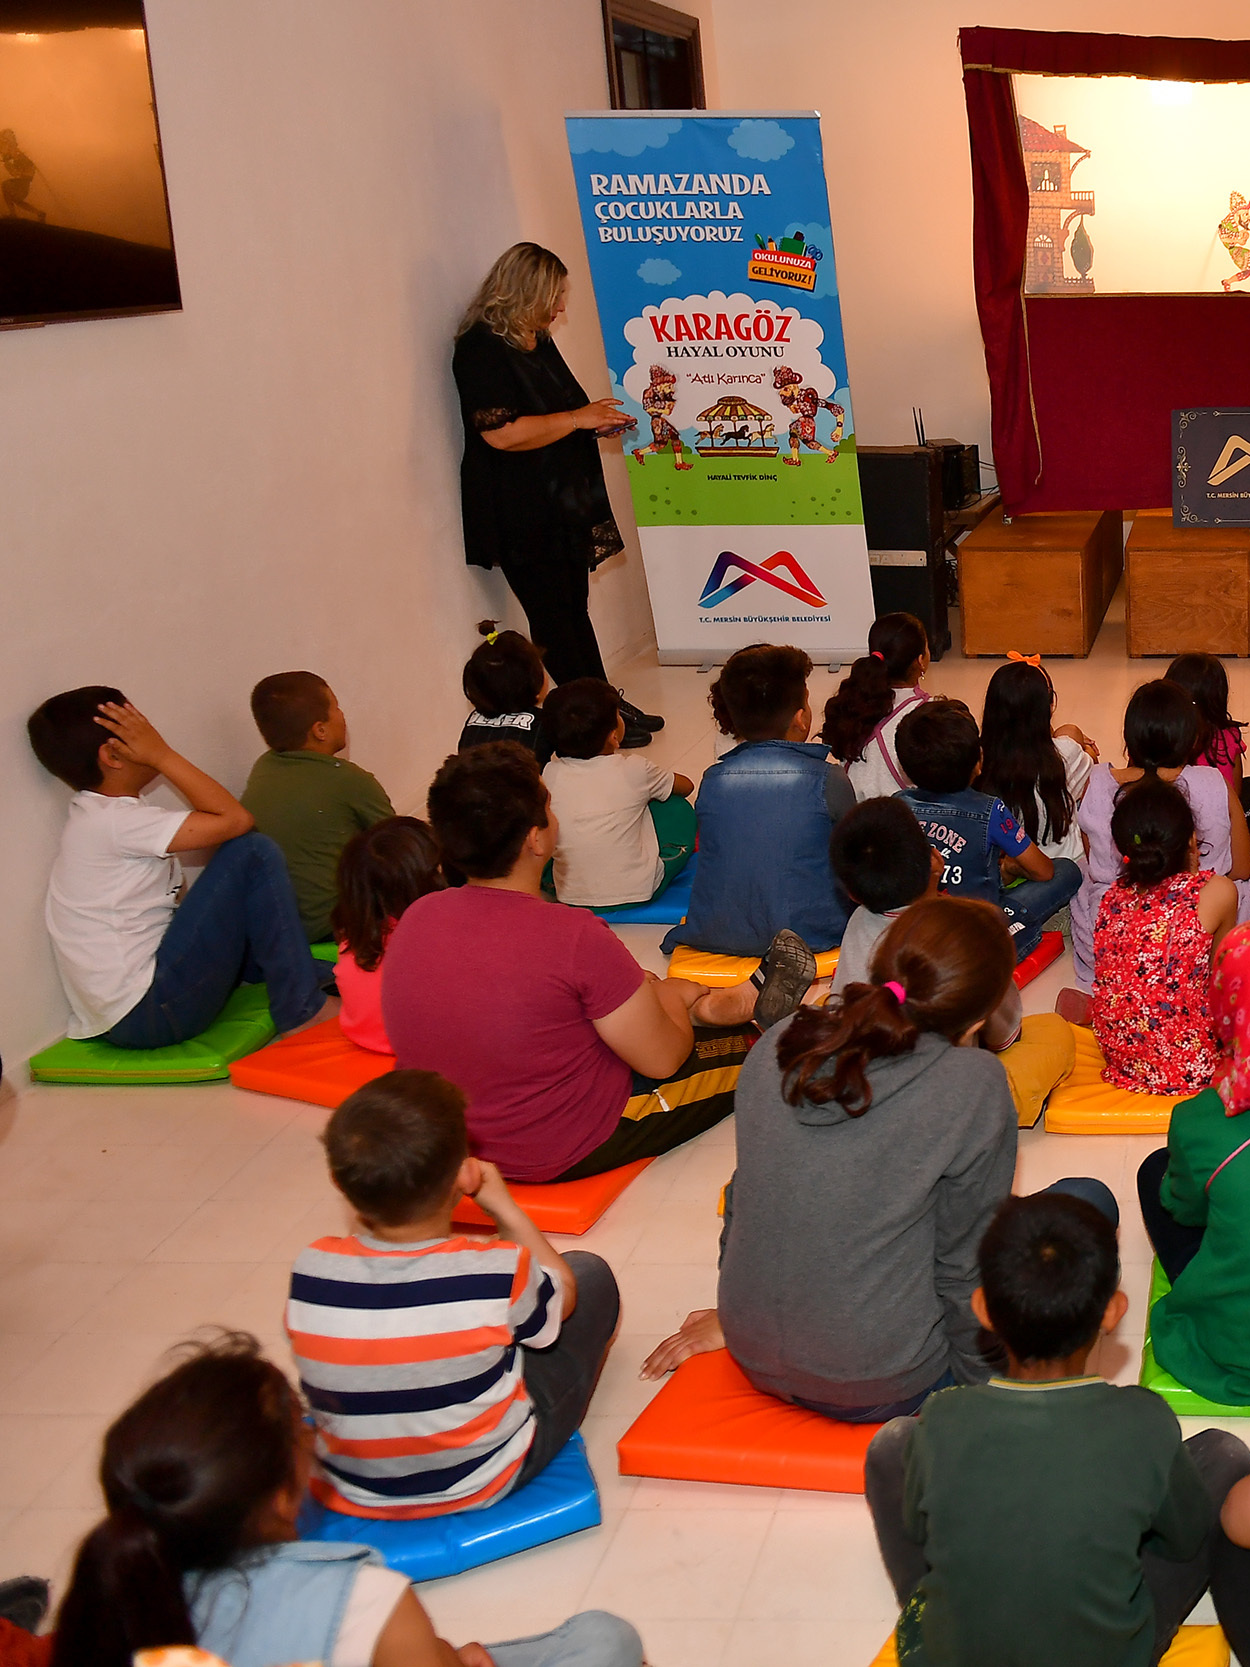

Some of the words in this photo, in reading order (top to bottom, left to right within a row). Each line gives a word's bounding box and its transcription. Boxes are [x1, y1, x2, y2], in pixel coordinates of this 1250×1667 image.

[590, 173, 772, 196] RAMAZANDA
[594, 201, 744, 224] ÇOCUKLARLA
[599, 225, 744, 246] BULUŞUYORUZ
[754, 252, 813, 269] OKULUNUZA
[649, 308, 793, 344] KARAGÖZ
[666, 346, 723, 359] HAYAL
[725, 346, 785, 359] OYUNU
[707, 473, 732, 481] HAYALİ
[733, 473, 758, 481] TEVFİK
[759, 473, 778, 483] DİNÇ
[1217, 491, 1239, 499] MERSİN
[743, 615, 790, 624] BÜYÜKŞEHİR
[791, 615, 831, 623] BELEDİYESİ
[1000, 819, 1014, 834] 19
[927, 822, 967, 854] ZONE
[941, 865, 963, 885] 73
[1003, 907, 1015, 916] 3
